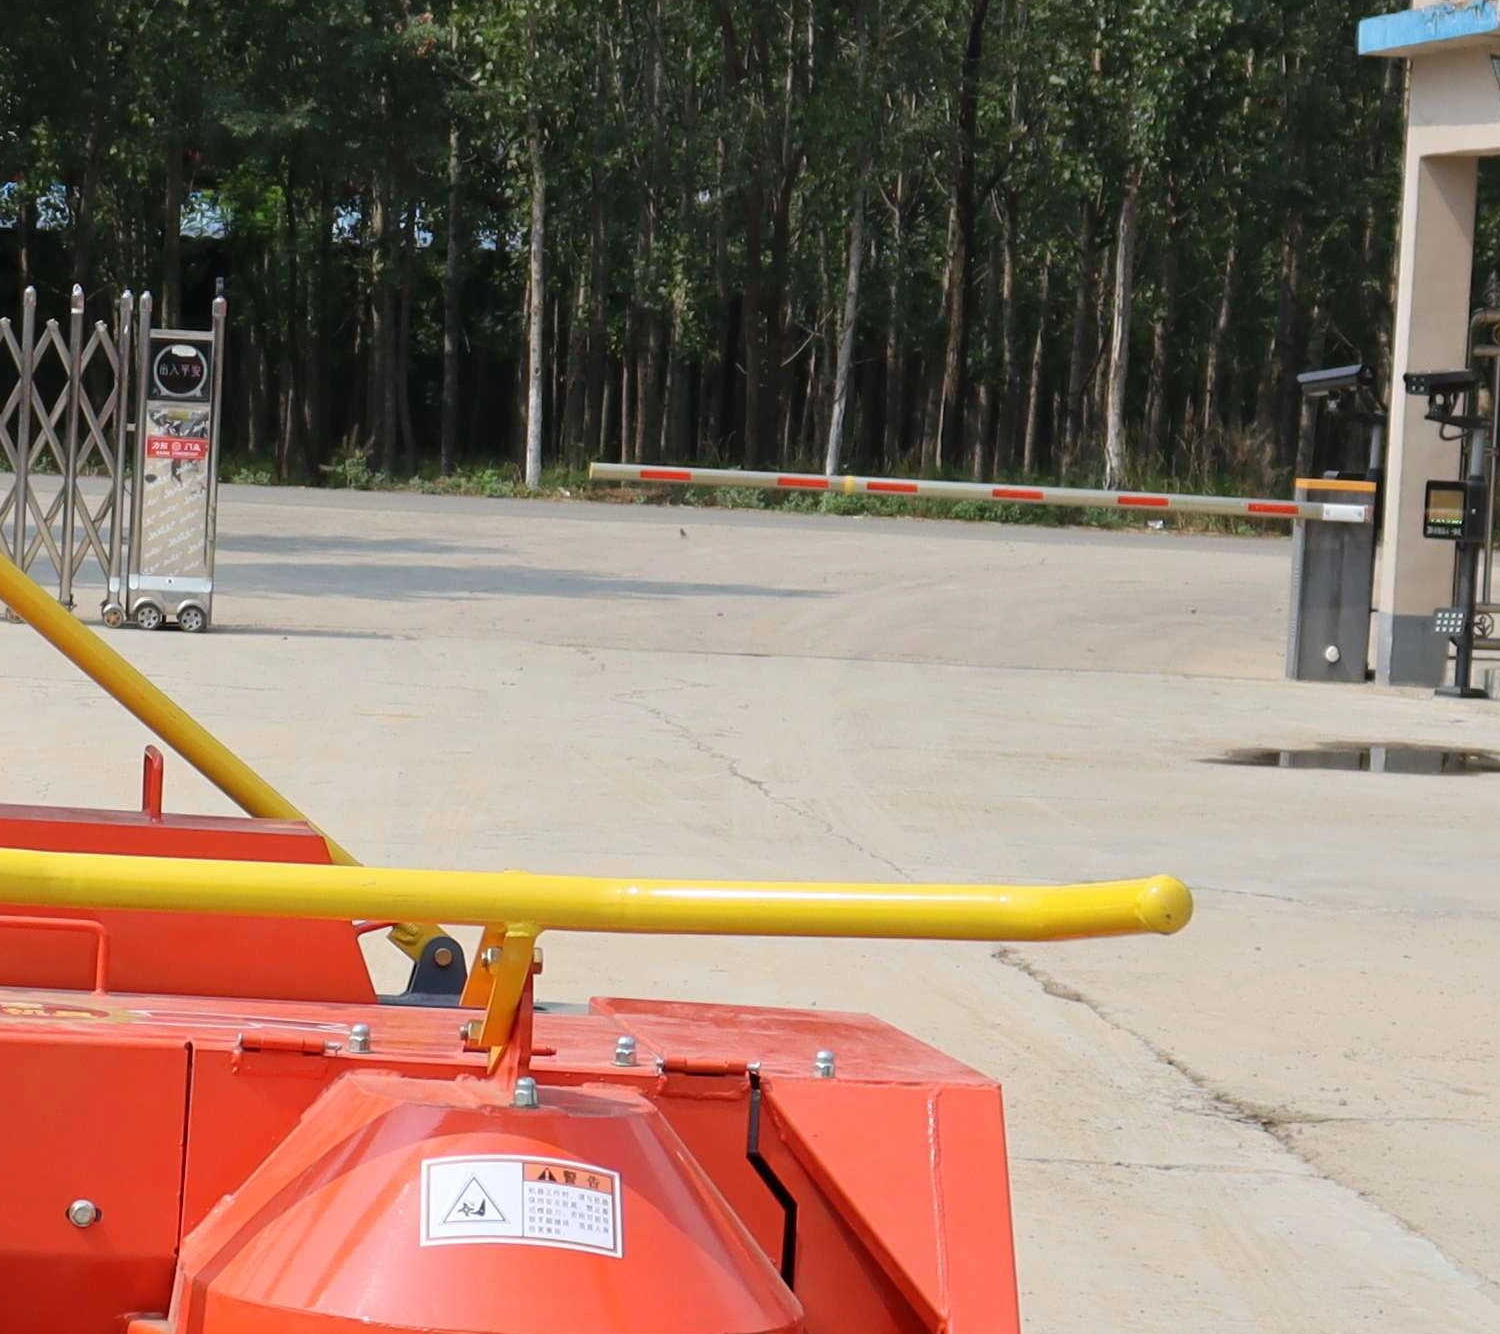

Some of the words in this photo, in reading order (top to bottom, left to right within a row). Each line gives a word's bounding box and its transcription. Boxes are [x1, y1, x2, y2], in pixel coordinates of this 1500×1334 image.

[159, 363, 202, 377] 出入平安
[563, 1170, 601, 1189] 警告
